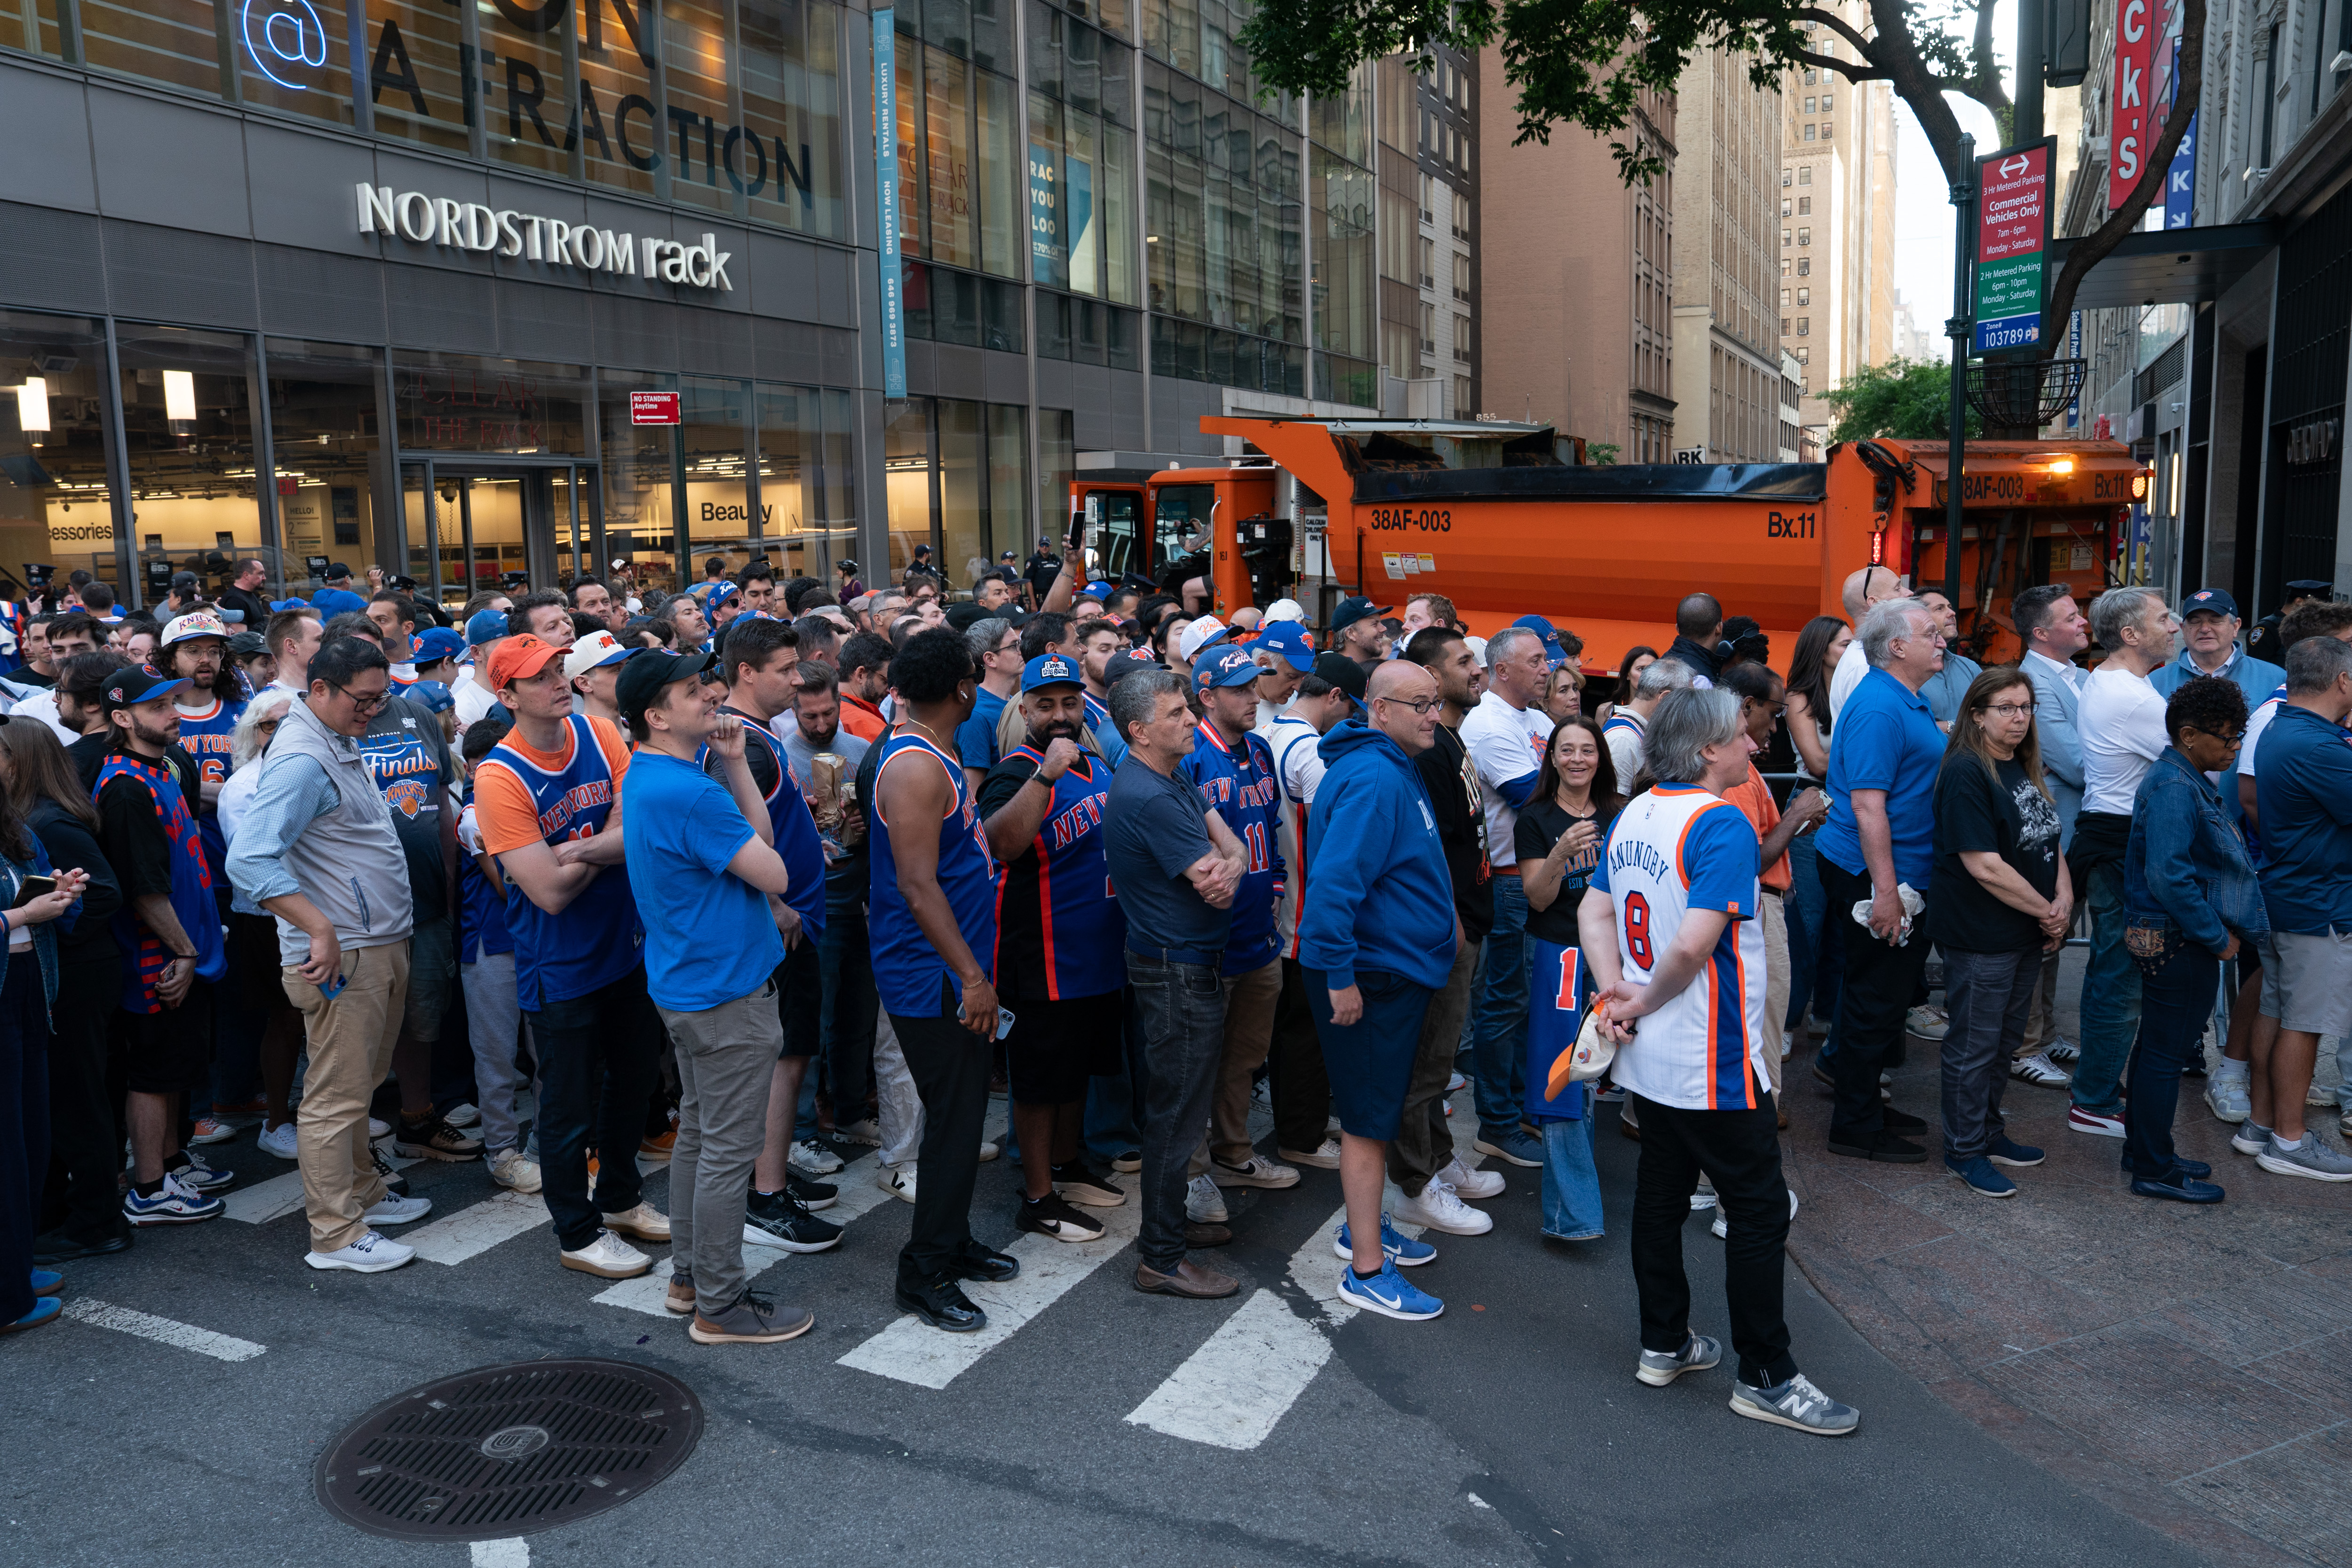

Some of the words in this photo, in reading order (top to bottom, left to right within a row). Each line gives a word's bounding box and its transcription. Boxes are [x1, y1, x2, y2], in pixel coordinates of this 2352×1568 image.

[372, 19, 430, 117] A
[459, 42, 811, 210] FRACTION
[882, 109, 890, 158] RENTALS
[908, 148, 969, 189] CEAR
[1988, 186, 1996, 194] Hr
[1996, 178, 2021, 193] Metered
[2022, 174, 2045, 186] Parking
[1031, 187, 1055, 208] YOU
[1989, 190, 2037, 212] Commercial
[1986, 210, 2018, 225] Vehicles
[2020, 204, 2040, 217] Only
[356, 182, 635, 276] NORDSTROM
[642, 233, 733, 292] rack
[1997, 229, 2009, 238] 7am
[2013, 225, 2026, 236] 6pm
[1037, 243, 1051, 255] 70%
[1986, 244, 2008, 255] Monday
[2012, 238, 2036, 250] Saturday
[1985, 271, 1993, 279] Hr
[1993, 265, 2017, 278] Metered
[2018, 263, 2041, 273] Parking
[1982, 294, 2005, 305] Monday
[2010, 288, 2036, 300] Saturday
[1992, 282, 2005, 292] 6pm
[2010, 279, 2027, 288] 10pm
[1986, 322, 2002, 330] Zone#
[2071, 310, 2080, 332] School
[1986, 328, 2023, 348] 103789
[419, 369, 539, 412] CLEAR
[1476, 413, 1496, 422] 855
[421, 415, 471, 444] THE
[481, 419, 546, 448] RACK
[1672, 450, 1703, 464] RK
[278, 479, 297, 494] EXIT
[1962, 476, 2023, 500] 8AF-003
[2095, 473, 2124, 499] Bx.11
[701, 501, 772, 525] Beauy
[1371, 509, 1451, 533] 38AF-003
[288, 522, 295, 535] 2
[1767, 511, 1816, 539] Bx.11
[199, 734, 237, 754] YOR
[361, 747, 437, 779] Finals
[386, 782, 426, 803] KNICKS
[539, 796, 574, 839] NEW
[565, 779, 612, 813] YORK
[1052, 796, 1102, 851] NEW
[1243, 820, 1269, 875] 11
[1610, 840, 1669, 885] ANUNOBY
[1568, 877, 1583, 890] ESTD
[1624, 890, 1655, 971] 8
[1556, 947, 1579, 1011] 1
